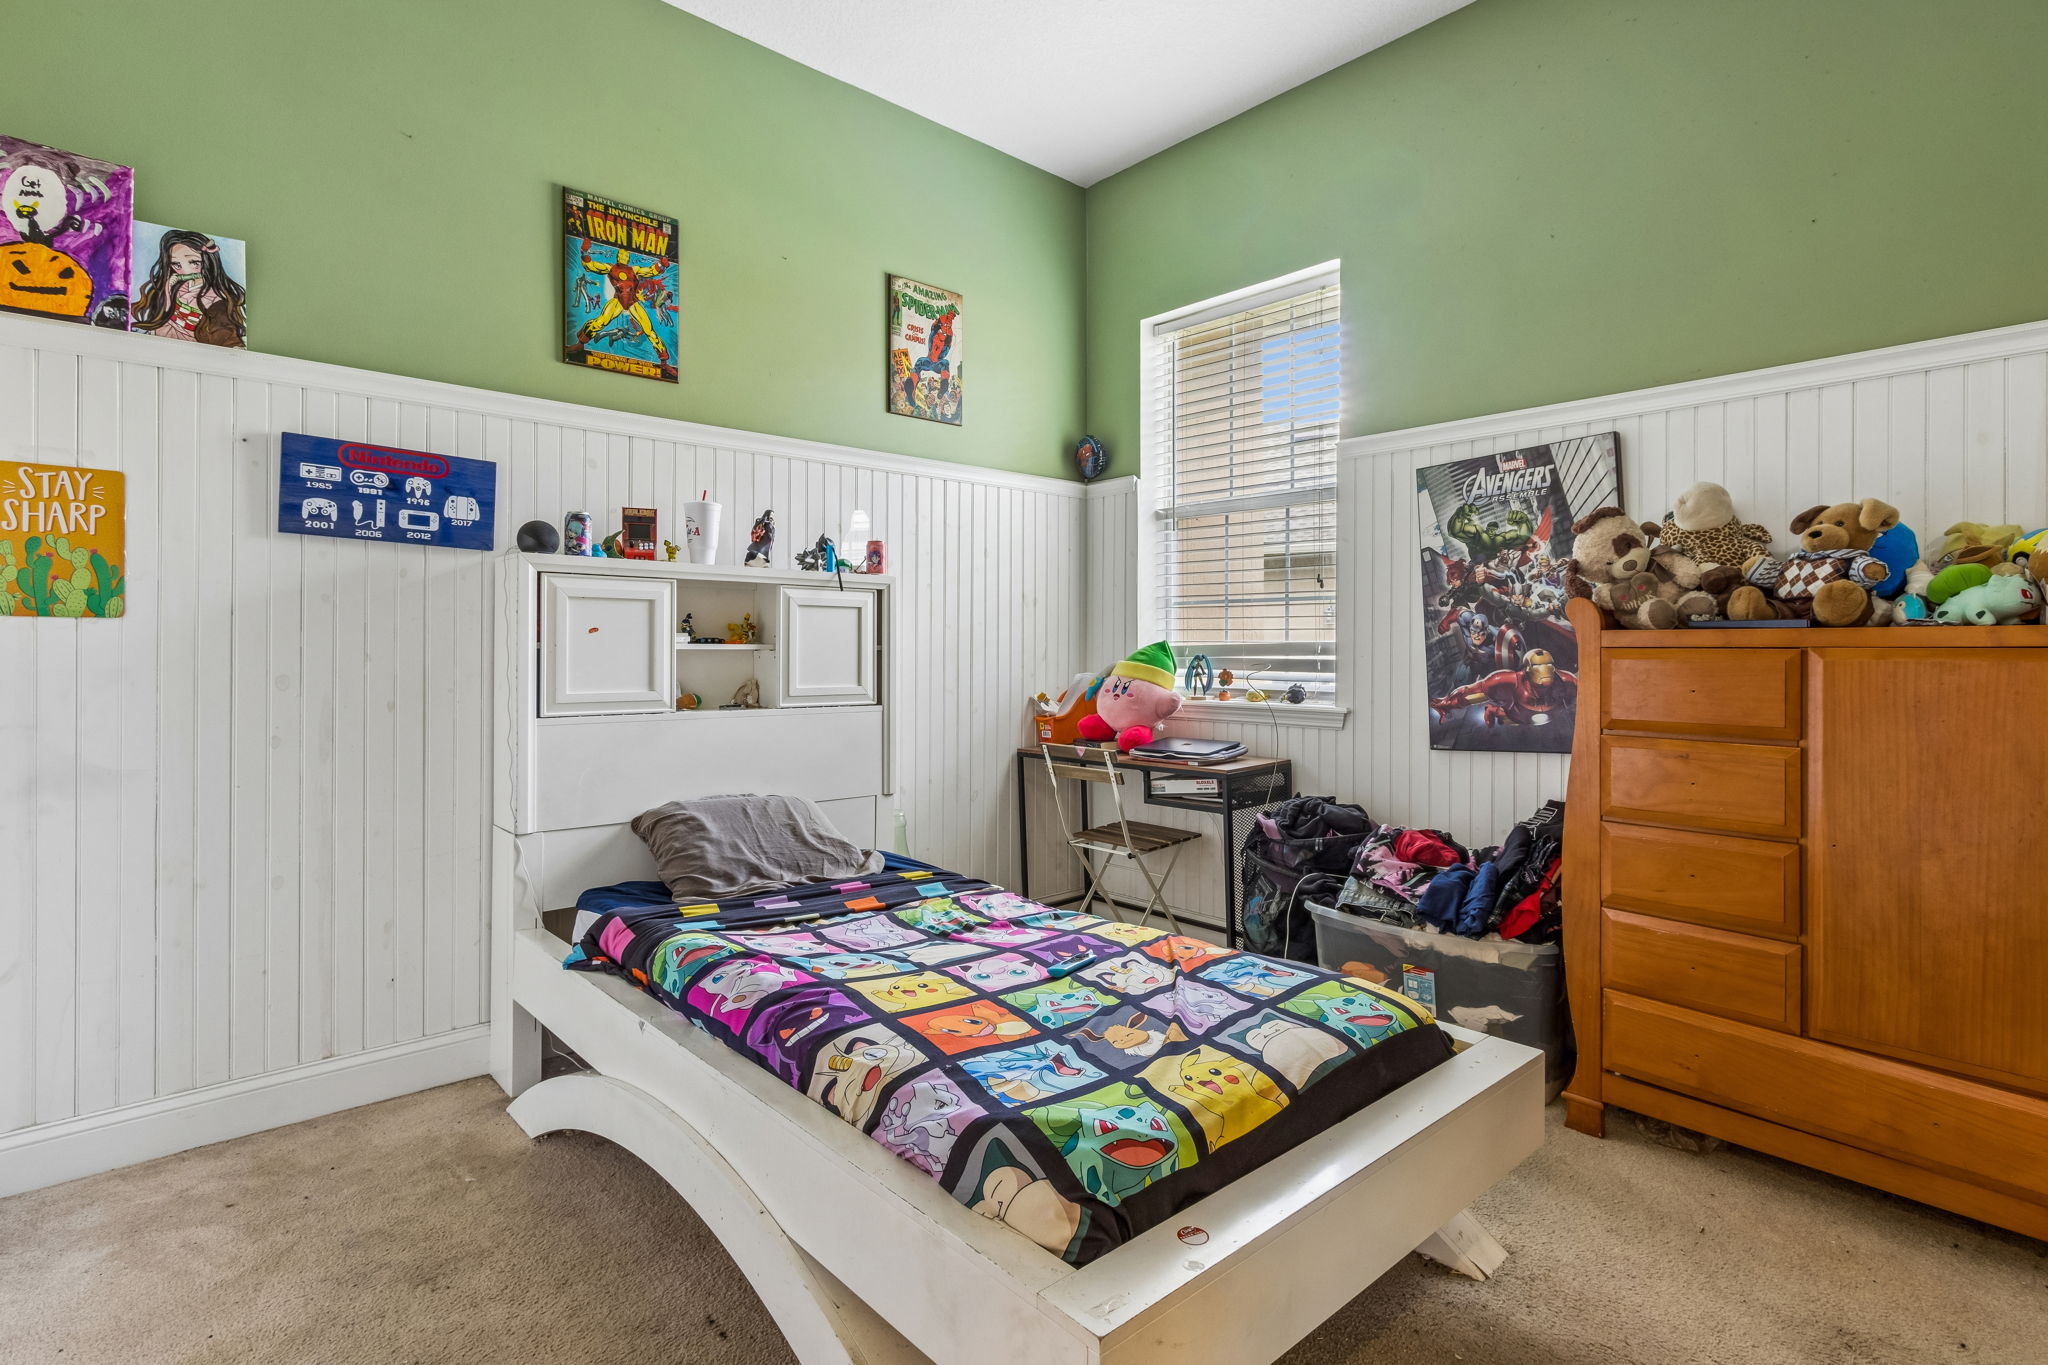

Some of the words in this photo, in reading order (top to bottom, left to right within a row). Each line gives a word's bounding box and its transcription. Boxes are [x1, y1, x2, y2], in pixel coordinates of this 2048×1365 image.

[21, 176, 41, 189] Get
[587, 194, 615, 207] MARVEL
[619, 203, 645, 215] COMICS
[587, 201, 605, 212] THE
[608, 207, 659, 227] INVINCIBLE
[586, 211, 628, 246] IRON
[632, 222, 669, 256] MAN
[913, 285, 947, 301] AMAZING
[907, 324, 924, 334] CRISIS
[587, 355, 661, 378] POWER!
[348, 449, 440, 473] Nintendo
[1502, 459, 1527, 471] MARVEL
[18, 466, 93, 500] STAY
[306, 481, 333, 490] 1985
[1463, 464, 1555, 505] AVENGERS
[357, 487, 383, 496] 1991
[1492, 488, 1548, 502] ASSEMBLE
[1, 498, 107, 535] SHARP
[451, 519, 473, 527] 2017
[305, 520, 335, 530] 2001
[355, 529, 382, 538] 2006
[406, 531, 432, 540] 2012
